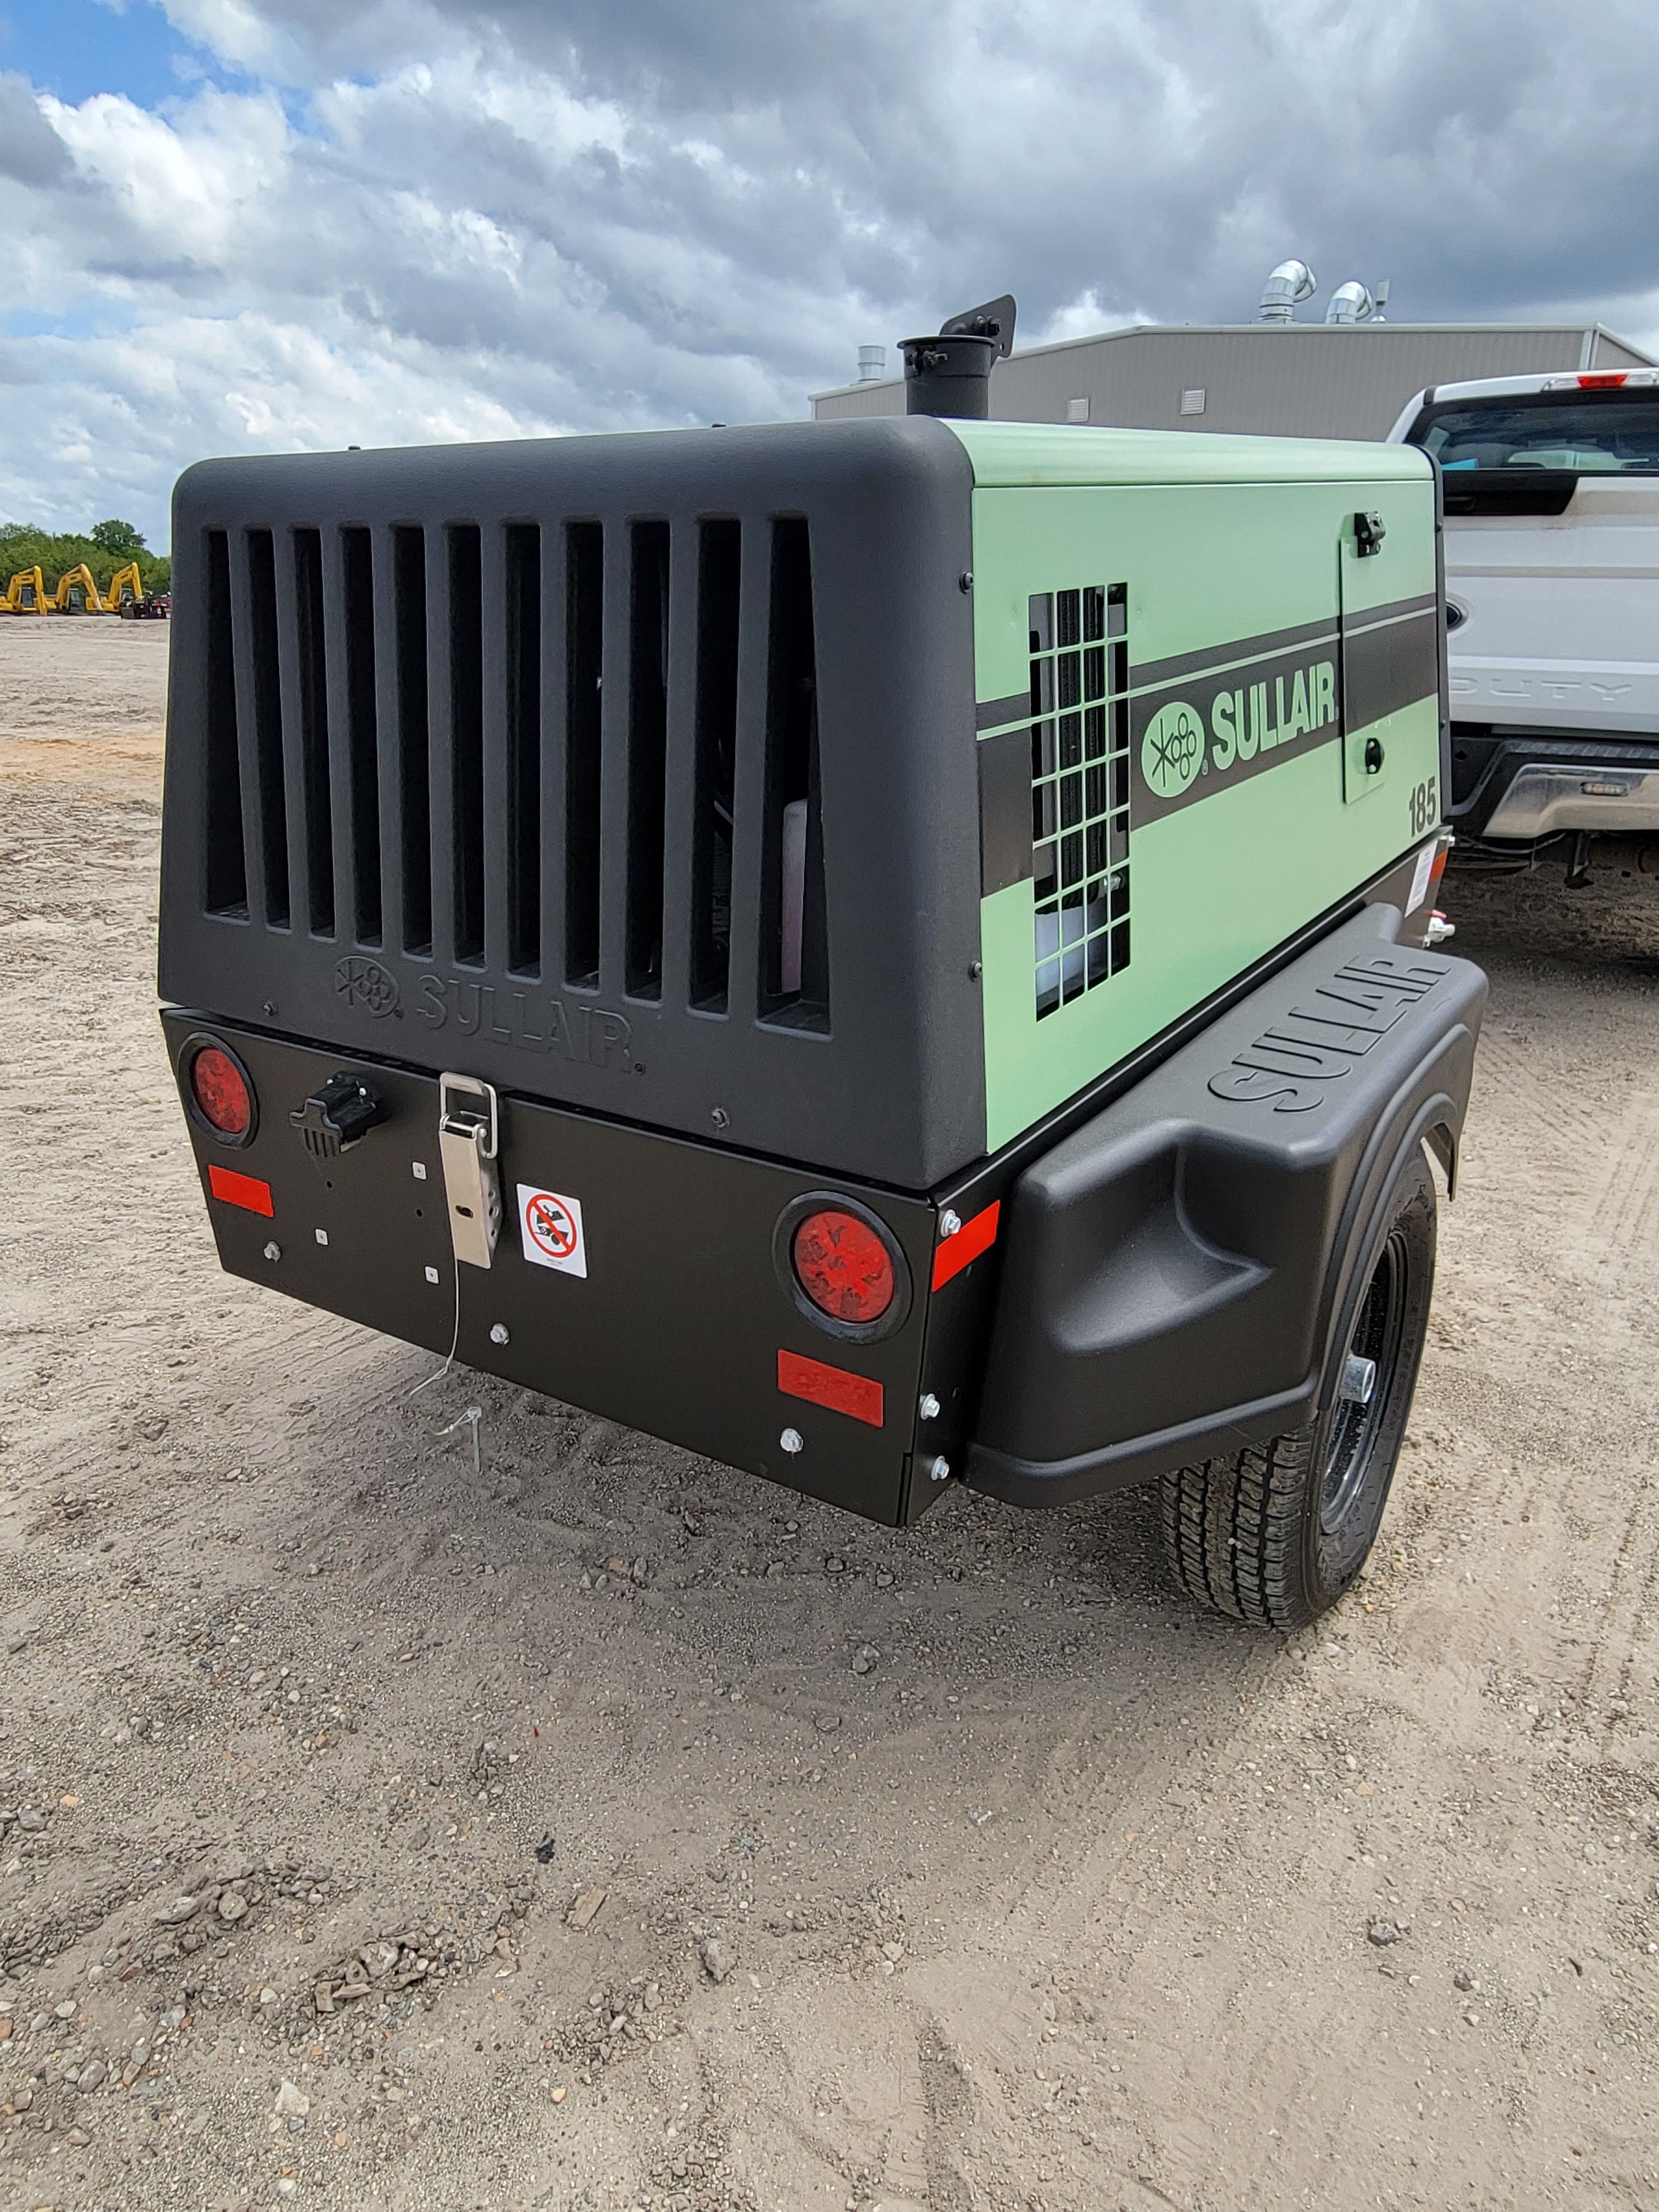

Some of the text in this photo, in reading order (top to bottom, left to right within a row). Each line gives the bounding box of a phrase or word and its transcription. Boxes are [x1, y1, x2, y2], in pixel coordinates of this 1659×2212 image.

[1211, 661, 1335, 770] SULLAIR
[1408, 775, 1436, 838] 185
[416, 974, 633, 1073] SULLAIR
[1207, 955, 1452, 1113] SULLAIR
